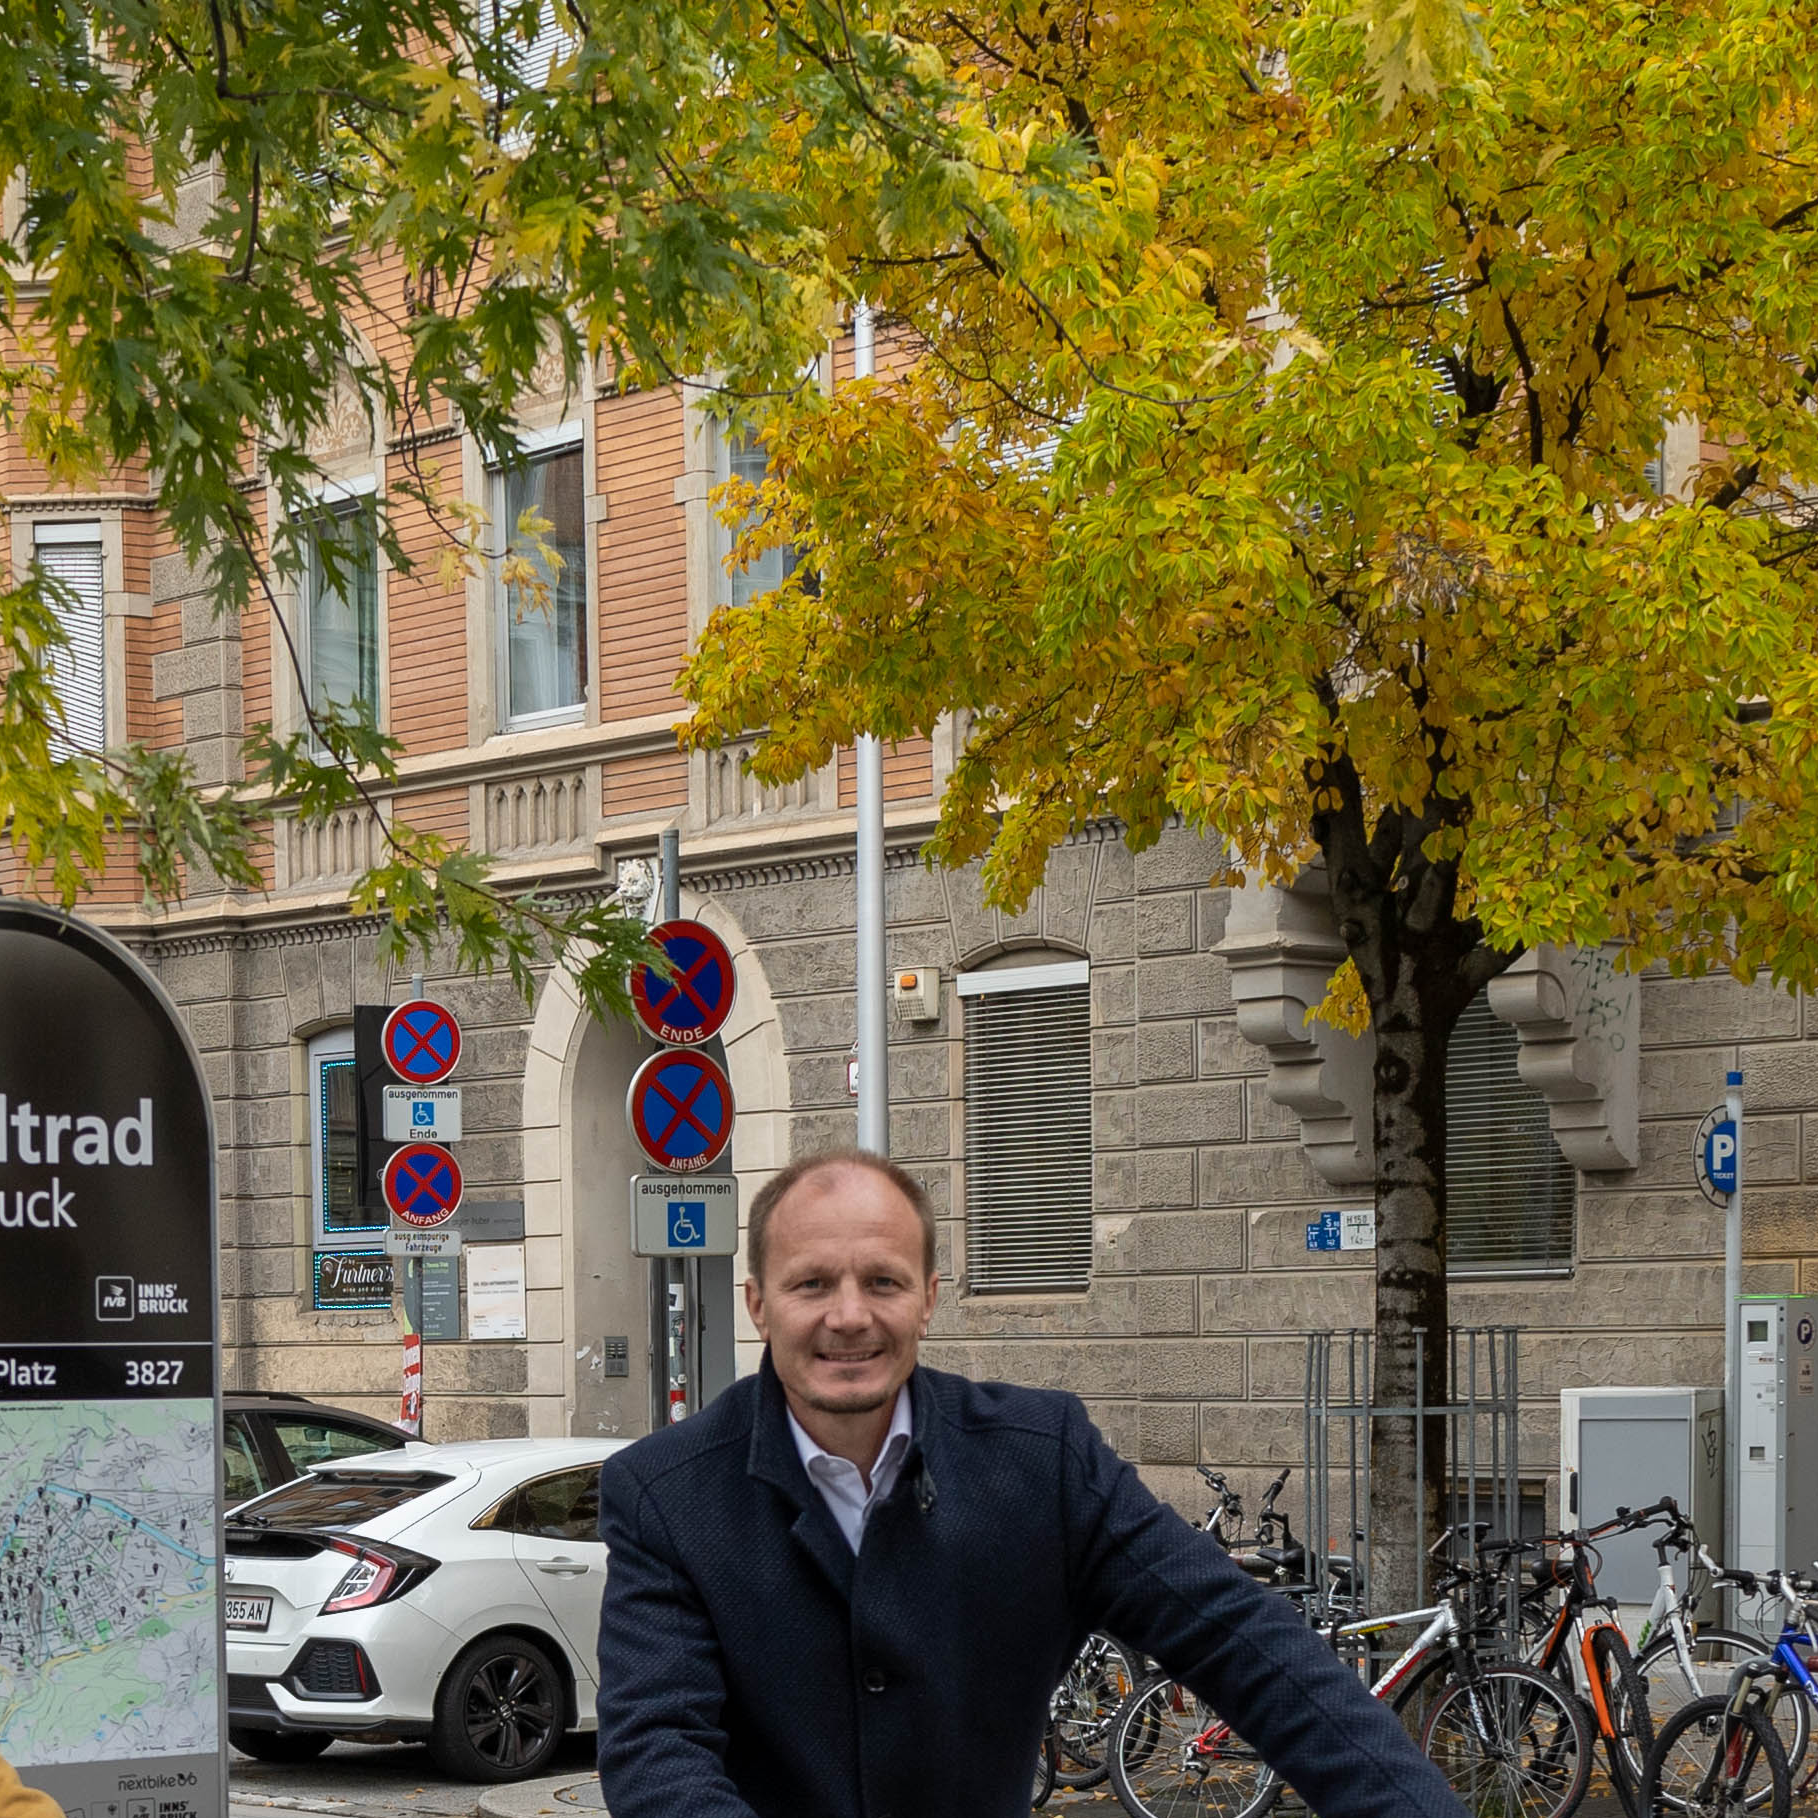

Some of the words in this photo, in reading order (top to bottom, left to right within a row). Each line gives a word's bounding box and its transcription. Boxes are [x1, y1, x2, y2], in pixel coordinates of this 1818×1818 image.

[659, 1024, 705, 1043] ENDE
[388, 1089, 459, 1101] ausgenommen
[409, 1128, 439, 1140] Ende
[1712, 1133, 1735, 1171] P
[668, 1152, 709, 1171] ANFANG
[640, 1181, 733, 1200] ausgenommen
[400, 1207, 450, 1226] ANFANG
[137, 1283, 179, 1299] INNS'
[103, 1296, 127, 1308] IVB
[137, 1298, 189, 1314] BRUCK
[125, 1360, 184, 1386] 3827
[246, 1602, 265, 1620] AN
[118, 1774, 176, 1791] nextbike
[159, 1801, 190, 1813] INNS'
